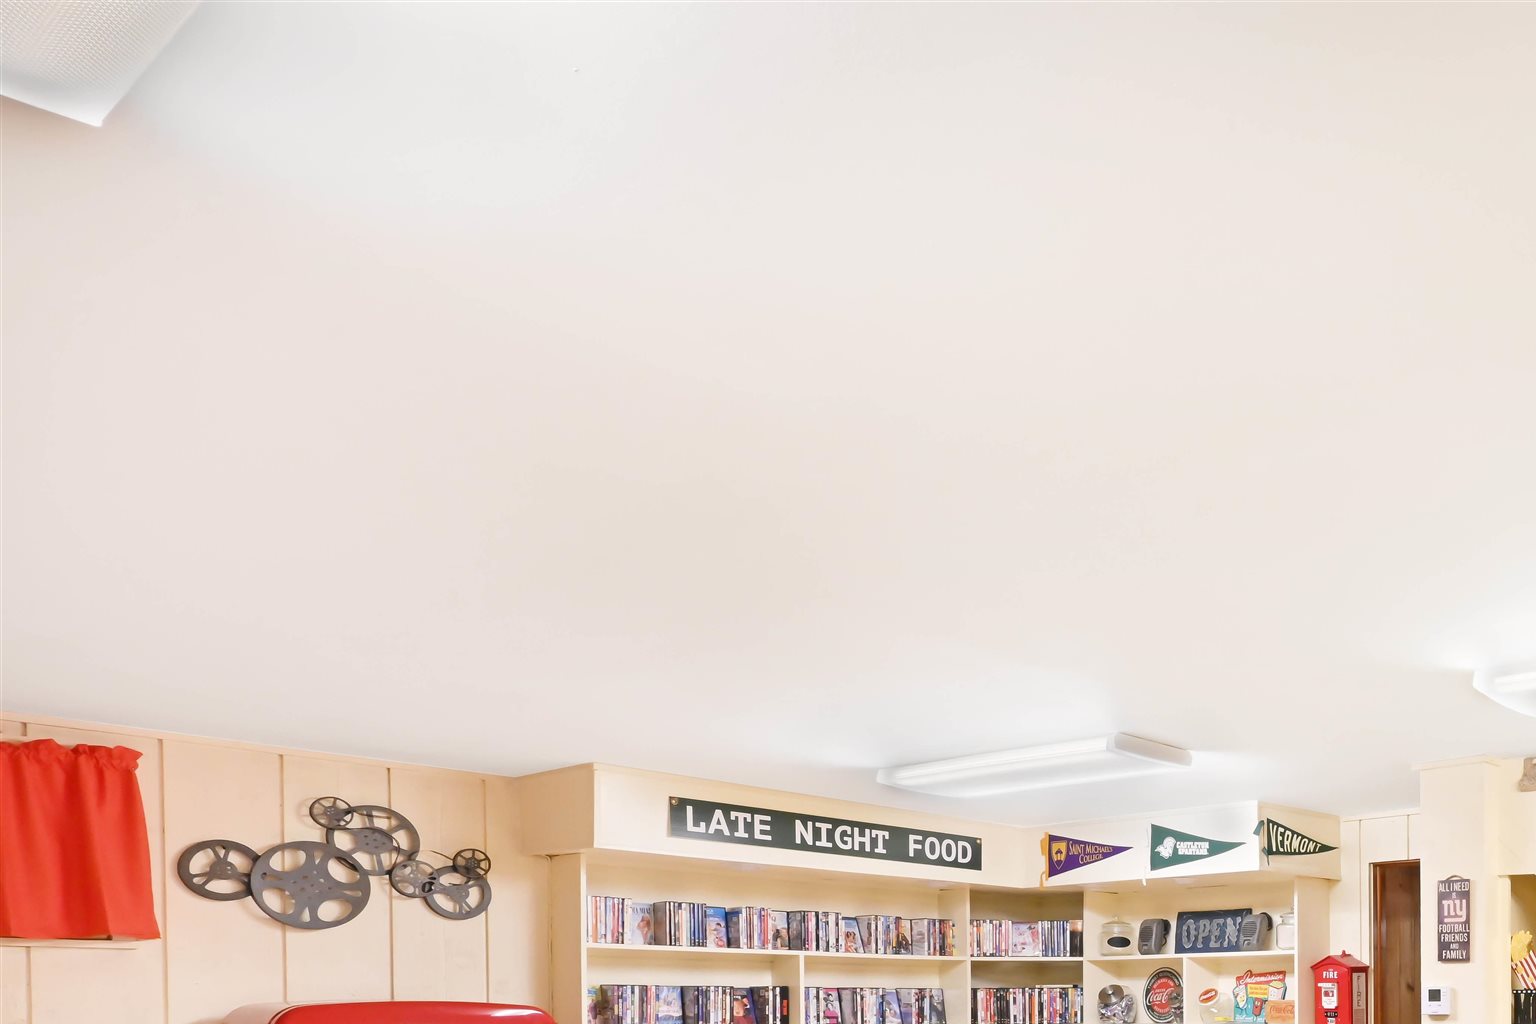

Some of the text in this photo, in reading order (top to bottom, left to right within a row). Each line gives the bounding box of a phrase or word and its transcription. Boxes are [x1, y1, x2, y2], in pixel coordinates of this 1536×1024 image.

[686, 805, 972, 863] LATE NIGHT FOOD
[1269, 823, 1322, 853] VERMONT
[1069, 841, 1085, 855] SAINT
[1079, 853, 1104, 864] COLLEGE
[1439, 882, 1450, 892] ALL
[1455, 881, 1470, 892] NEED
[1181, 916, 1242, 948] OPEN
[1439, 924, 1470, 933] FOOTBALL
[1441, 933, 1468, 942] FRIENDS
[1442, 950, 1467, 960] FAMILY
[1323, 971, 1338, 979] FIRE
